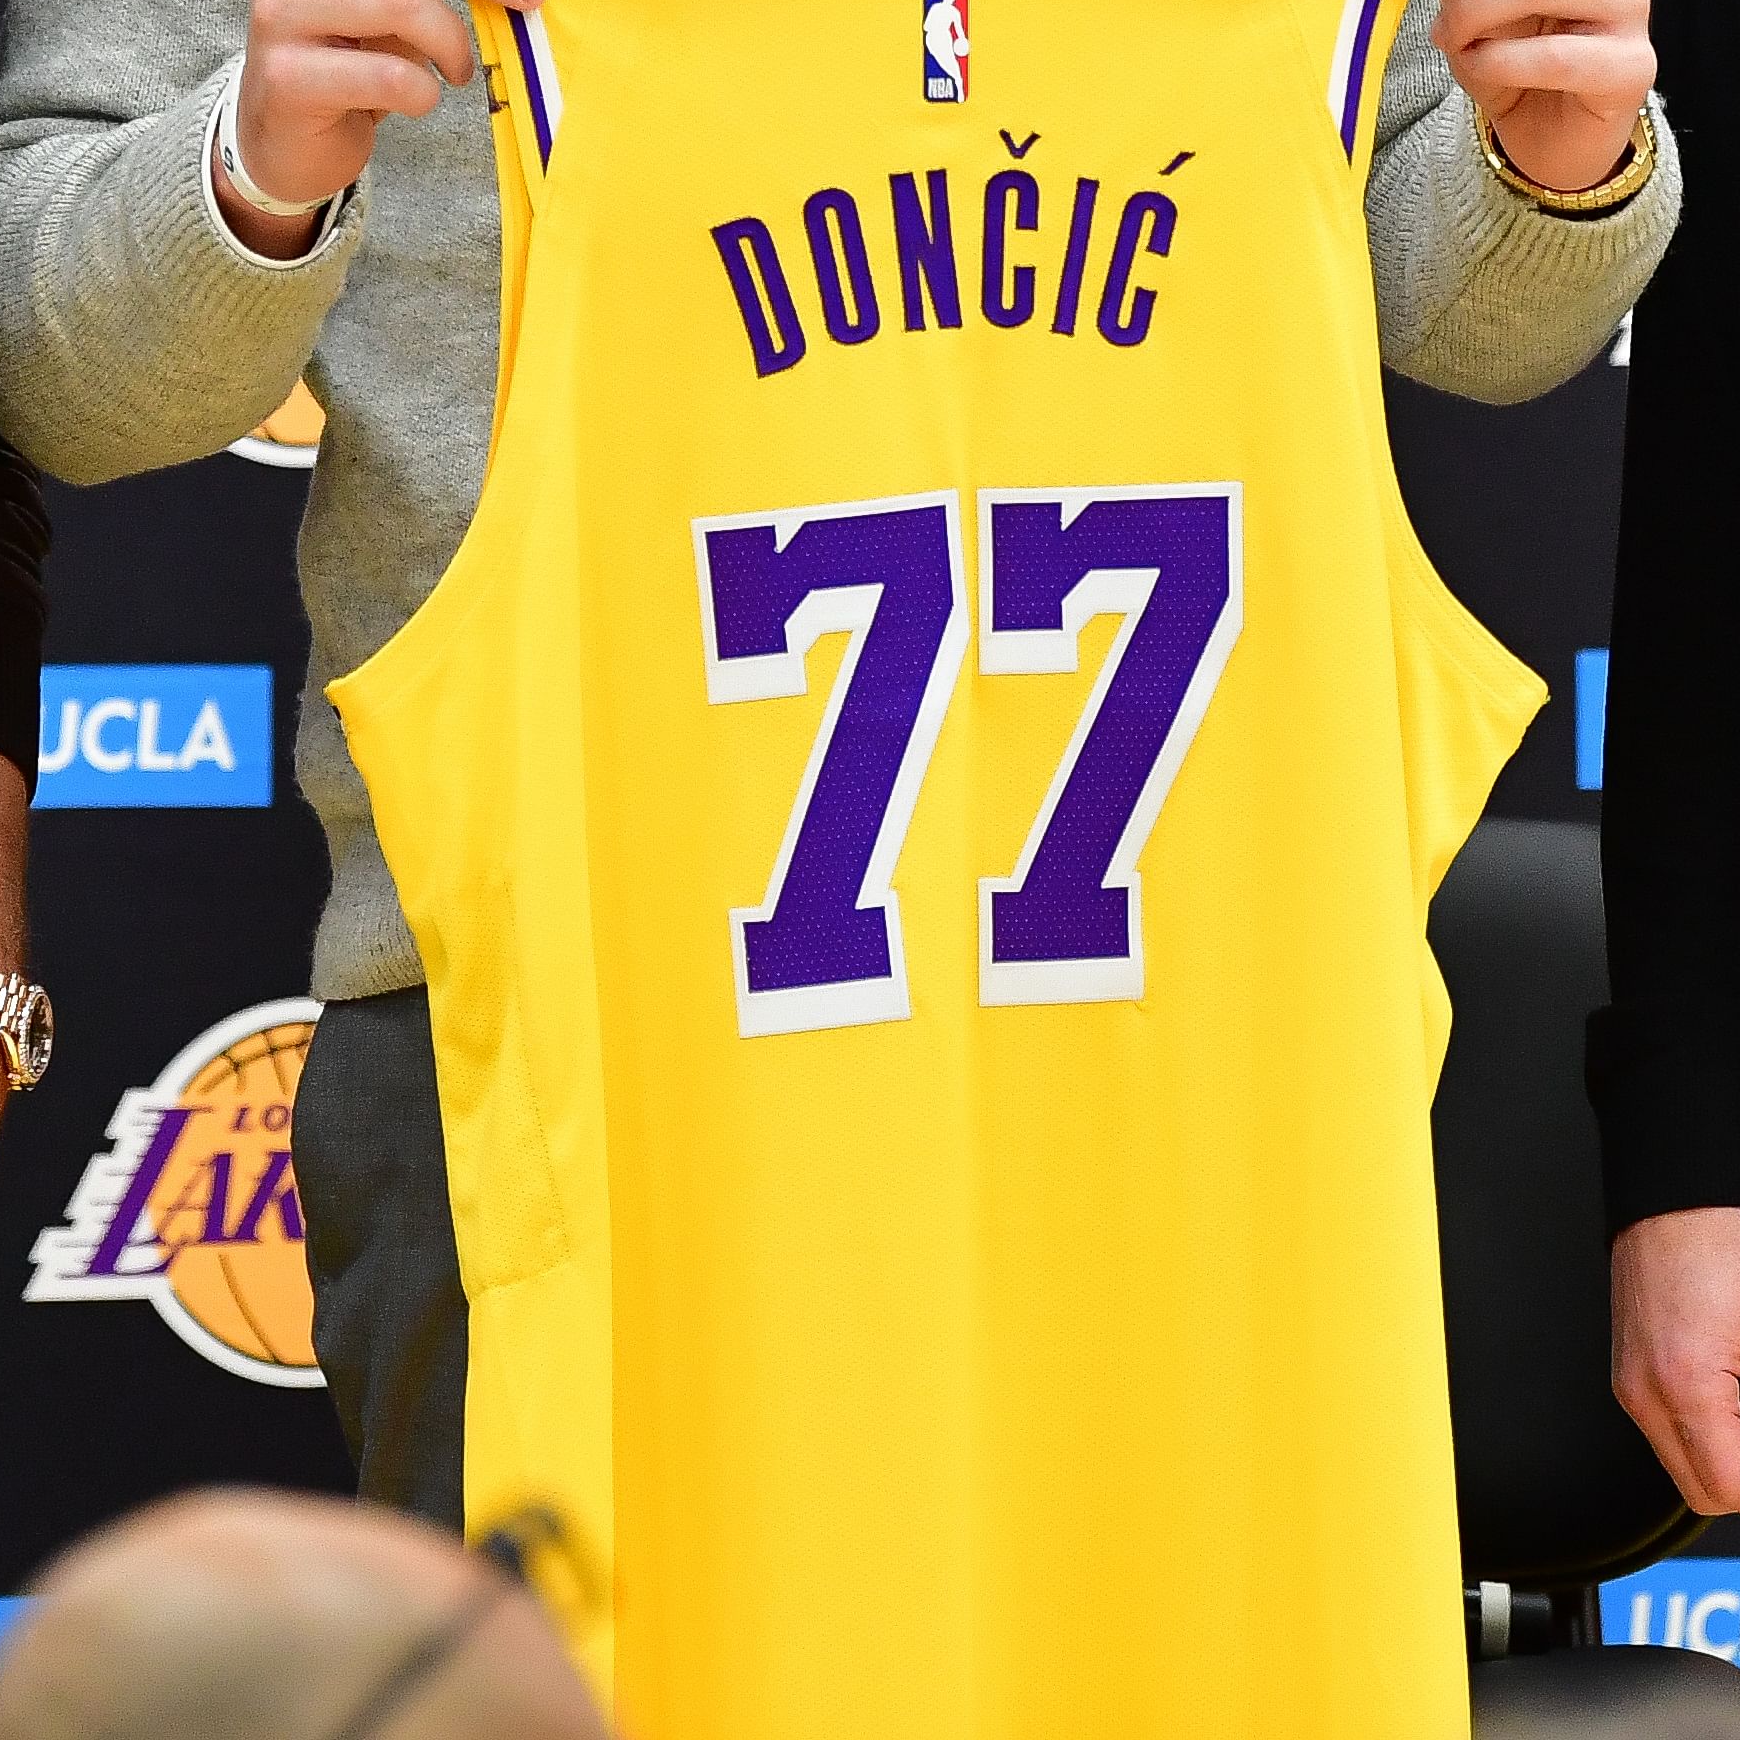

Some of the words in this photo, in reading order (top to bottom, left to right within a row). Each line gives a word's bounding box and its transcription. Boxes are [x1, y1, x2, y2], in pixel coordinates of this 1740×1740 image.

[927, 77, 954, 99] NBA
[709, 128, 1196, 379] DONČIĆ
[691, 480, 1244, 1040] 77
[55, 1104, 306, 1280] LAK
[231, 1103, 292, 1134] LO
